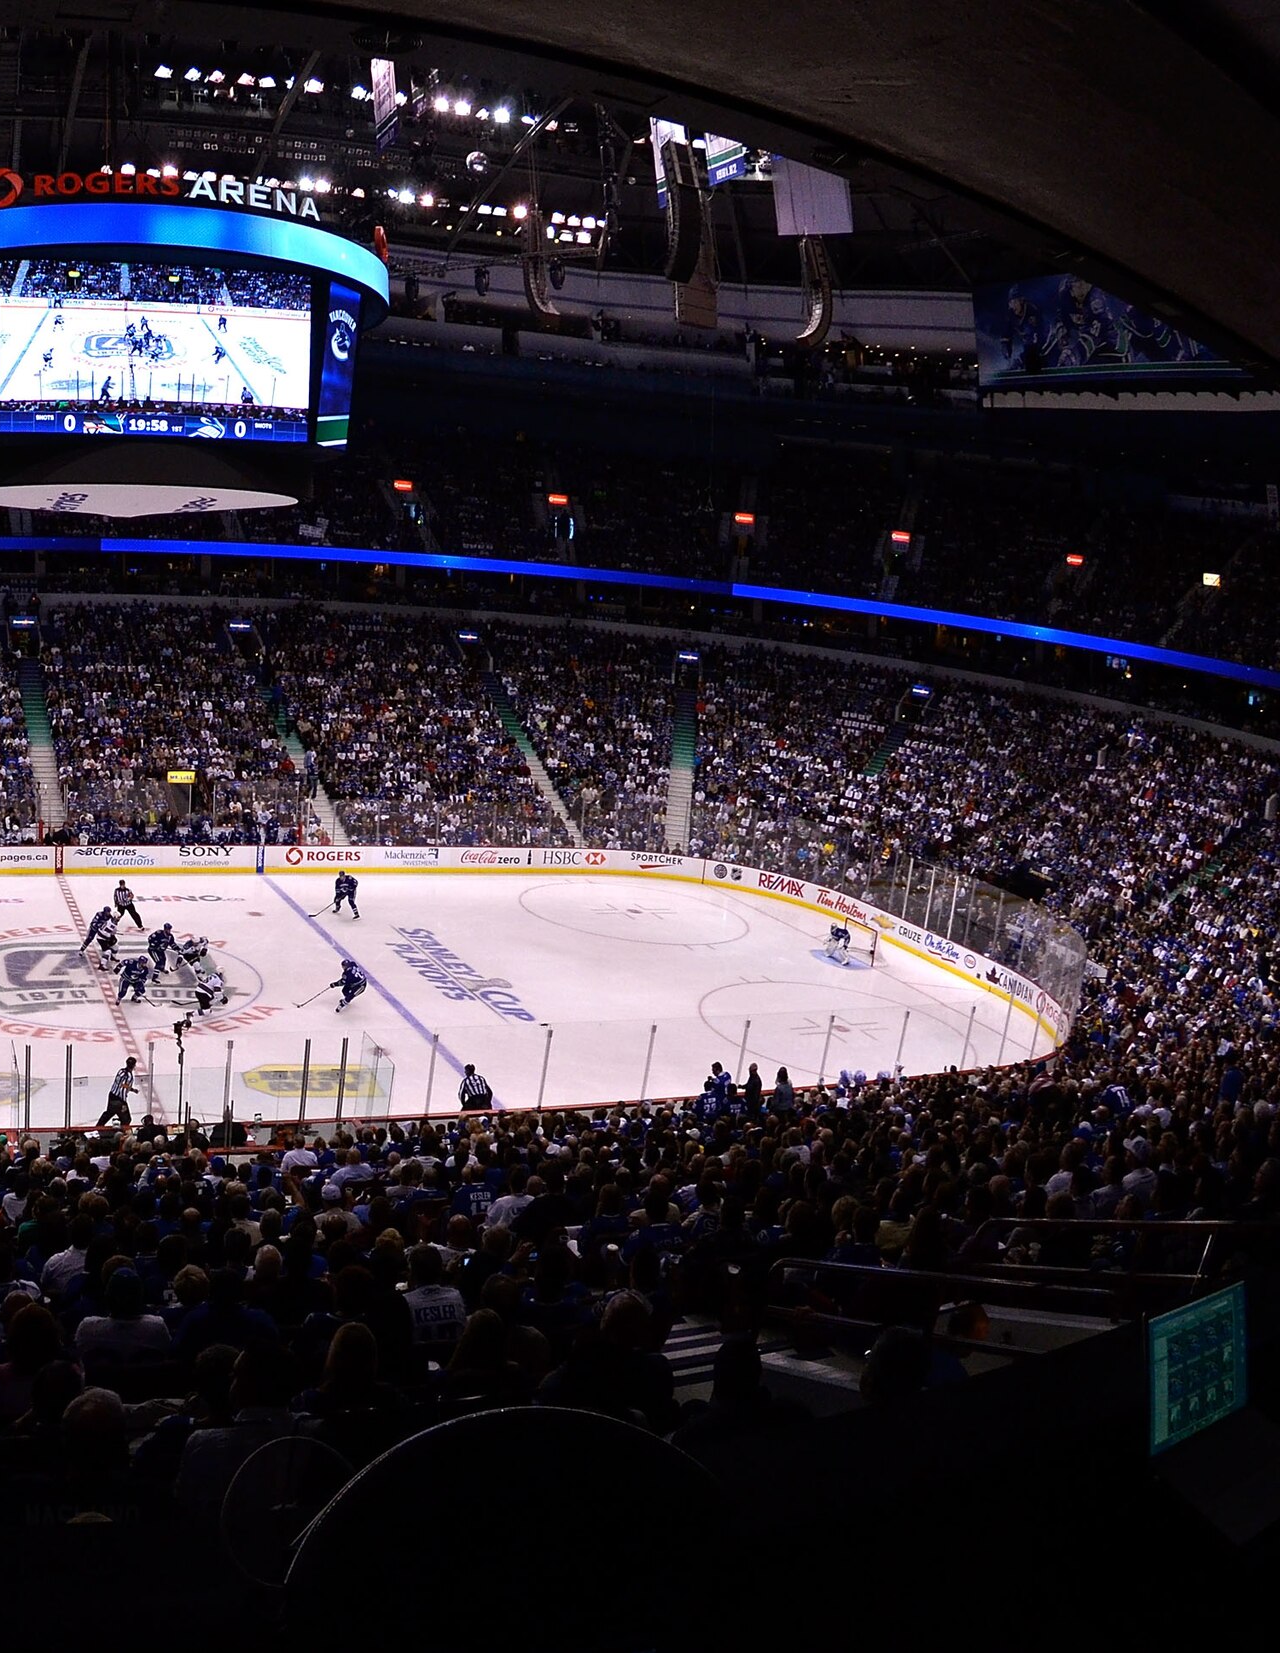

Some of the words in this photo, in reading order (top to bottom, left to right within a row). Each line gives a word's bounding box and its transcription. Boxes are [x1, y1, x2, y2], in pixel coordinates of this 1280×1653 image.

[34, 171, 180, 196] ROGERS
[187, 176, 321, 221] ARENA
[63, 414, 76, 432] 0
[128, 418, 168, 432] 19:58
[234, 420, 246, 438] 0
[105, 856, 155, 866] Vacations
[179, 846, 234, 857] SONY
[307, 850, 361, 862] ROGERS
[384, 850, 427, 860] Mackenzie
[497, 856, 520, 864] zero
[543, 851, 582, 865] HSBC
[758, 872, 805, 898] RE/MAX
[816, 887, 835, 909] Tim
[835, 895, 868, 923] Hortons
[898, 925, 922, 944] CRUZE
[385, 942, 477, 1001] PLAYOFFS
[399, 927, 485, 980] STANLEY
[479, 990, 536, 1022] CUP
[999, 972, 1034, 1004] CANADIAN
[470, 1191, 491, 1202] KESLER
[414, 1304, 457, 1325] KESLER
